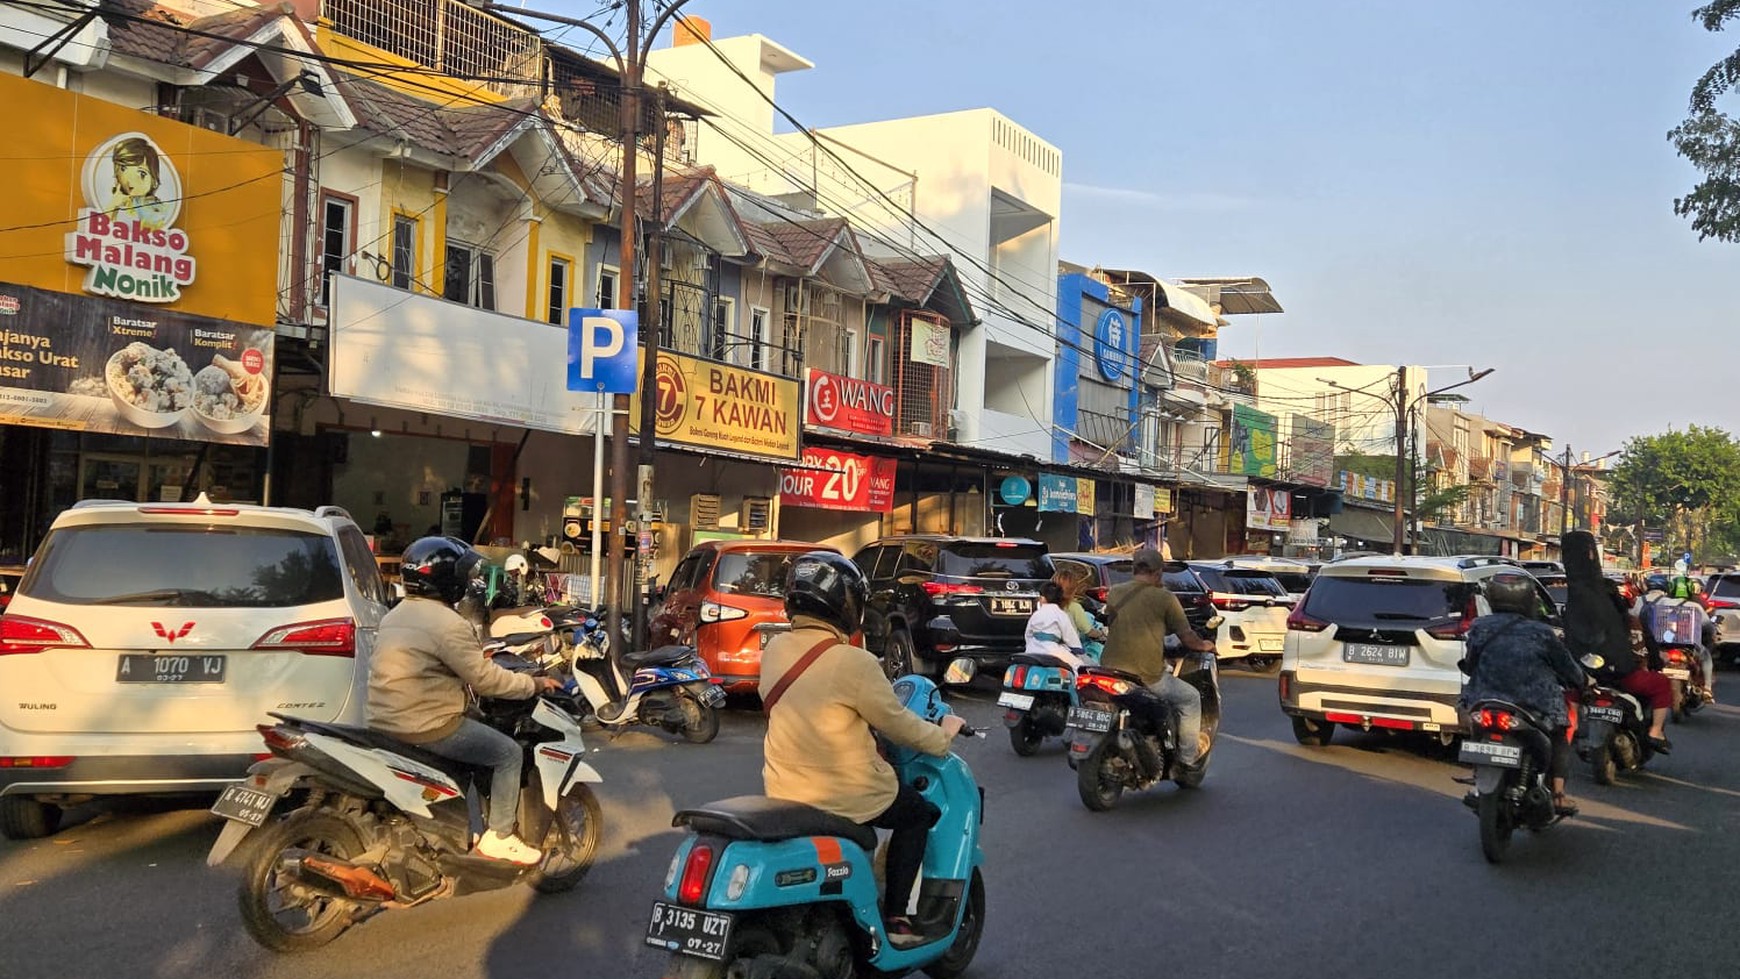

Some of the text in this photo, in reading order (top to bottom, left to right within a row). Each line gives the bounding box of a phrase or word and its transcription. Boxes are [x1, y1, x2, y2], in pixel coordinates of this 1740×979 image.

[89, 211, 185, 250] Bakso
[76, 235, 192, 282] Malang
[93, 267, 176, 298] Nonik
[0, 346, 80, 368] kso Urat
[580, 317, 625, 379] P
[0, 365, 31, 379] sar
[710, 368, 776, 406] BAKMI
[659, 381, 671, 411] 7
[840, 379, 893, 416] WANG
[695, 395, 787, 436] 7 KAWAN
[822, 455, 859, 502] 20
[121, 656, 222, 675] A 1070 VJ
[1360, 646, 1383, 657] 2624
[18, 702, 57, 710] WULING
[654, 907, 728, 937] B 3135 UZT
